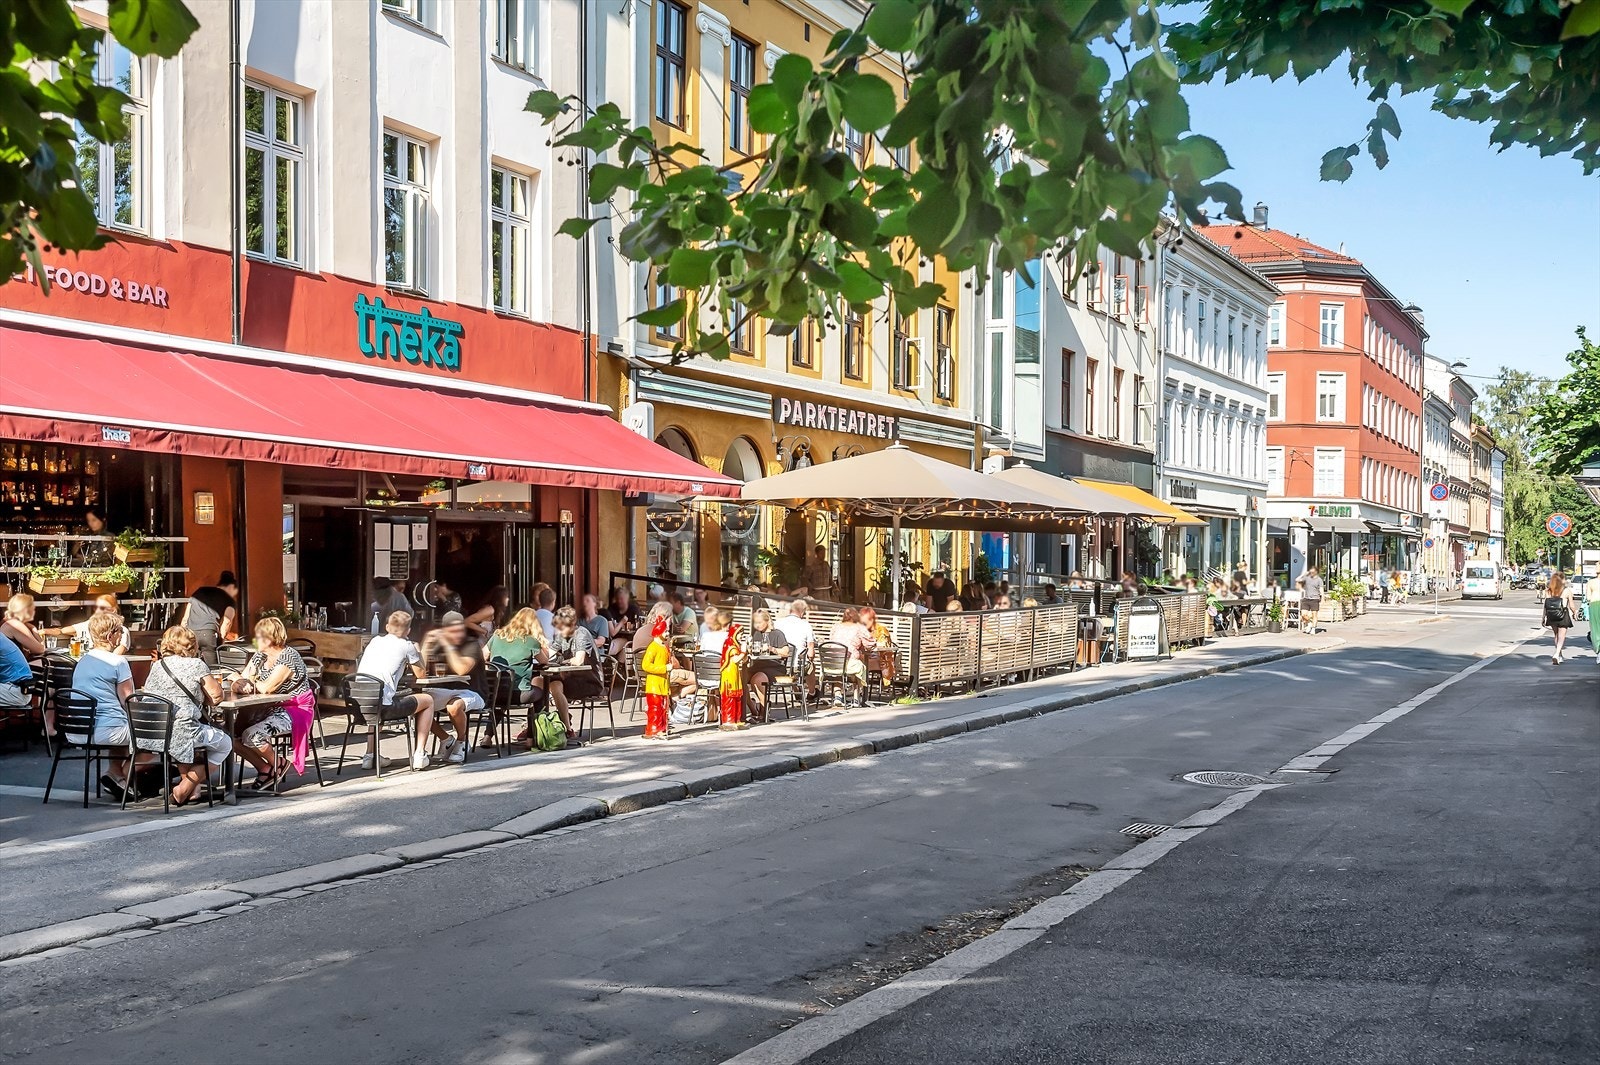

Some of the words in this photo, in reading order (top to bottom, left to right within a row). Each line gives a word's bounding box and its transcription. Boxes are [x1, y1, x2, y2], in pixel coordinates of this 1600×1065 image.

[44, 264, 107, 296] FOOD
[109, 277, 125, 299] &
[127, 281, 168, 307] BAR
[354, 293, 464, 369] theka
[779, 397, 895, 440] PARKTEATRET
